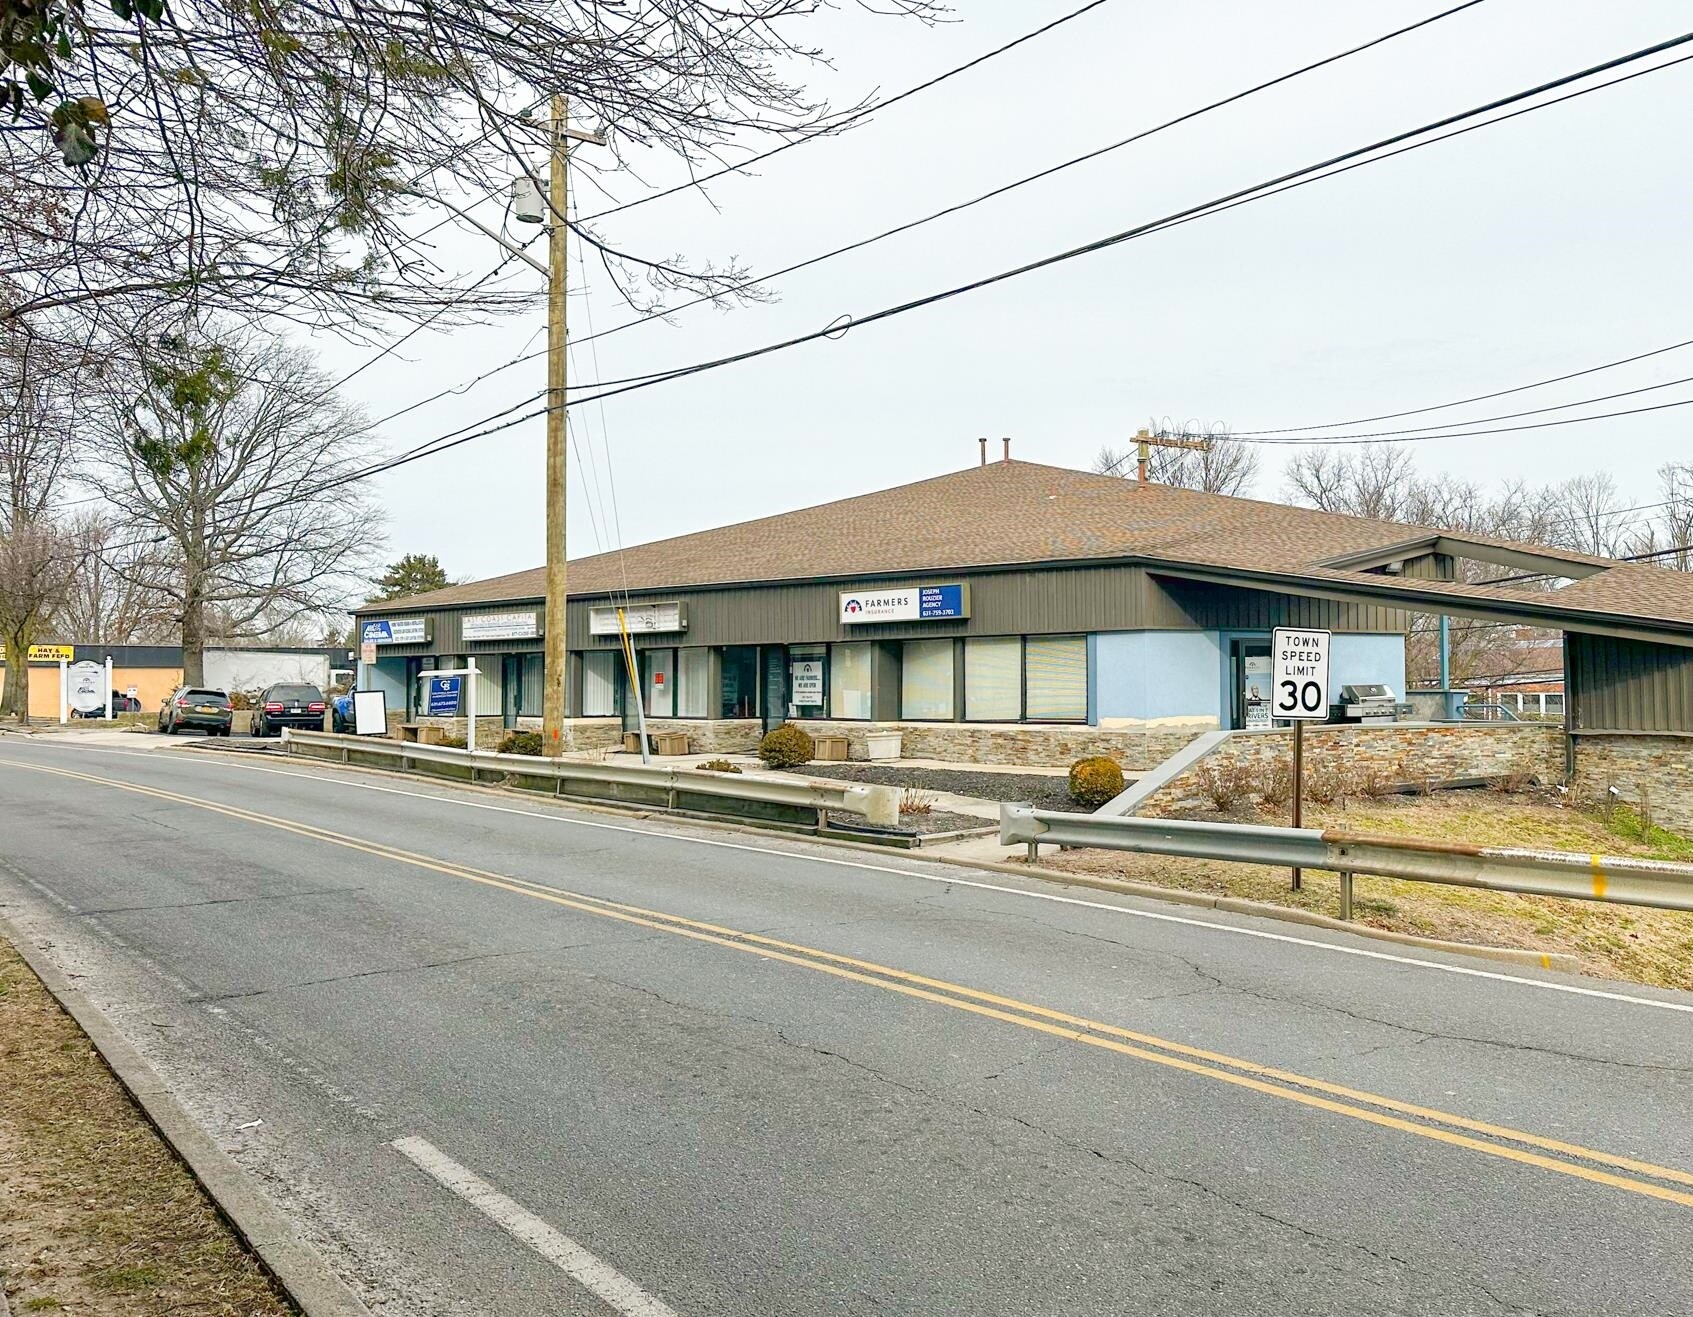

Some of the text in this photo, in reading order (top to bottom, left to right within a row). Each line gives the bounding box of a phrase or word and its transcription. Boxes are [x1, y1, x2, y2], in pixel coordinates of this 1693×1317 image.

[865, 597, 909, 608] FARMERS
[1285, 636, 1319, 647] TOWN
[1281, 650, 1321, 662] SPEED
[1285, 665, 1316, 676] LIMIT
[1278, 679, 1322, 712] 30
